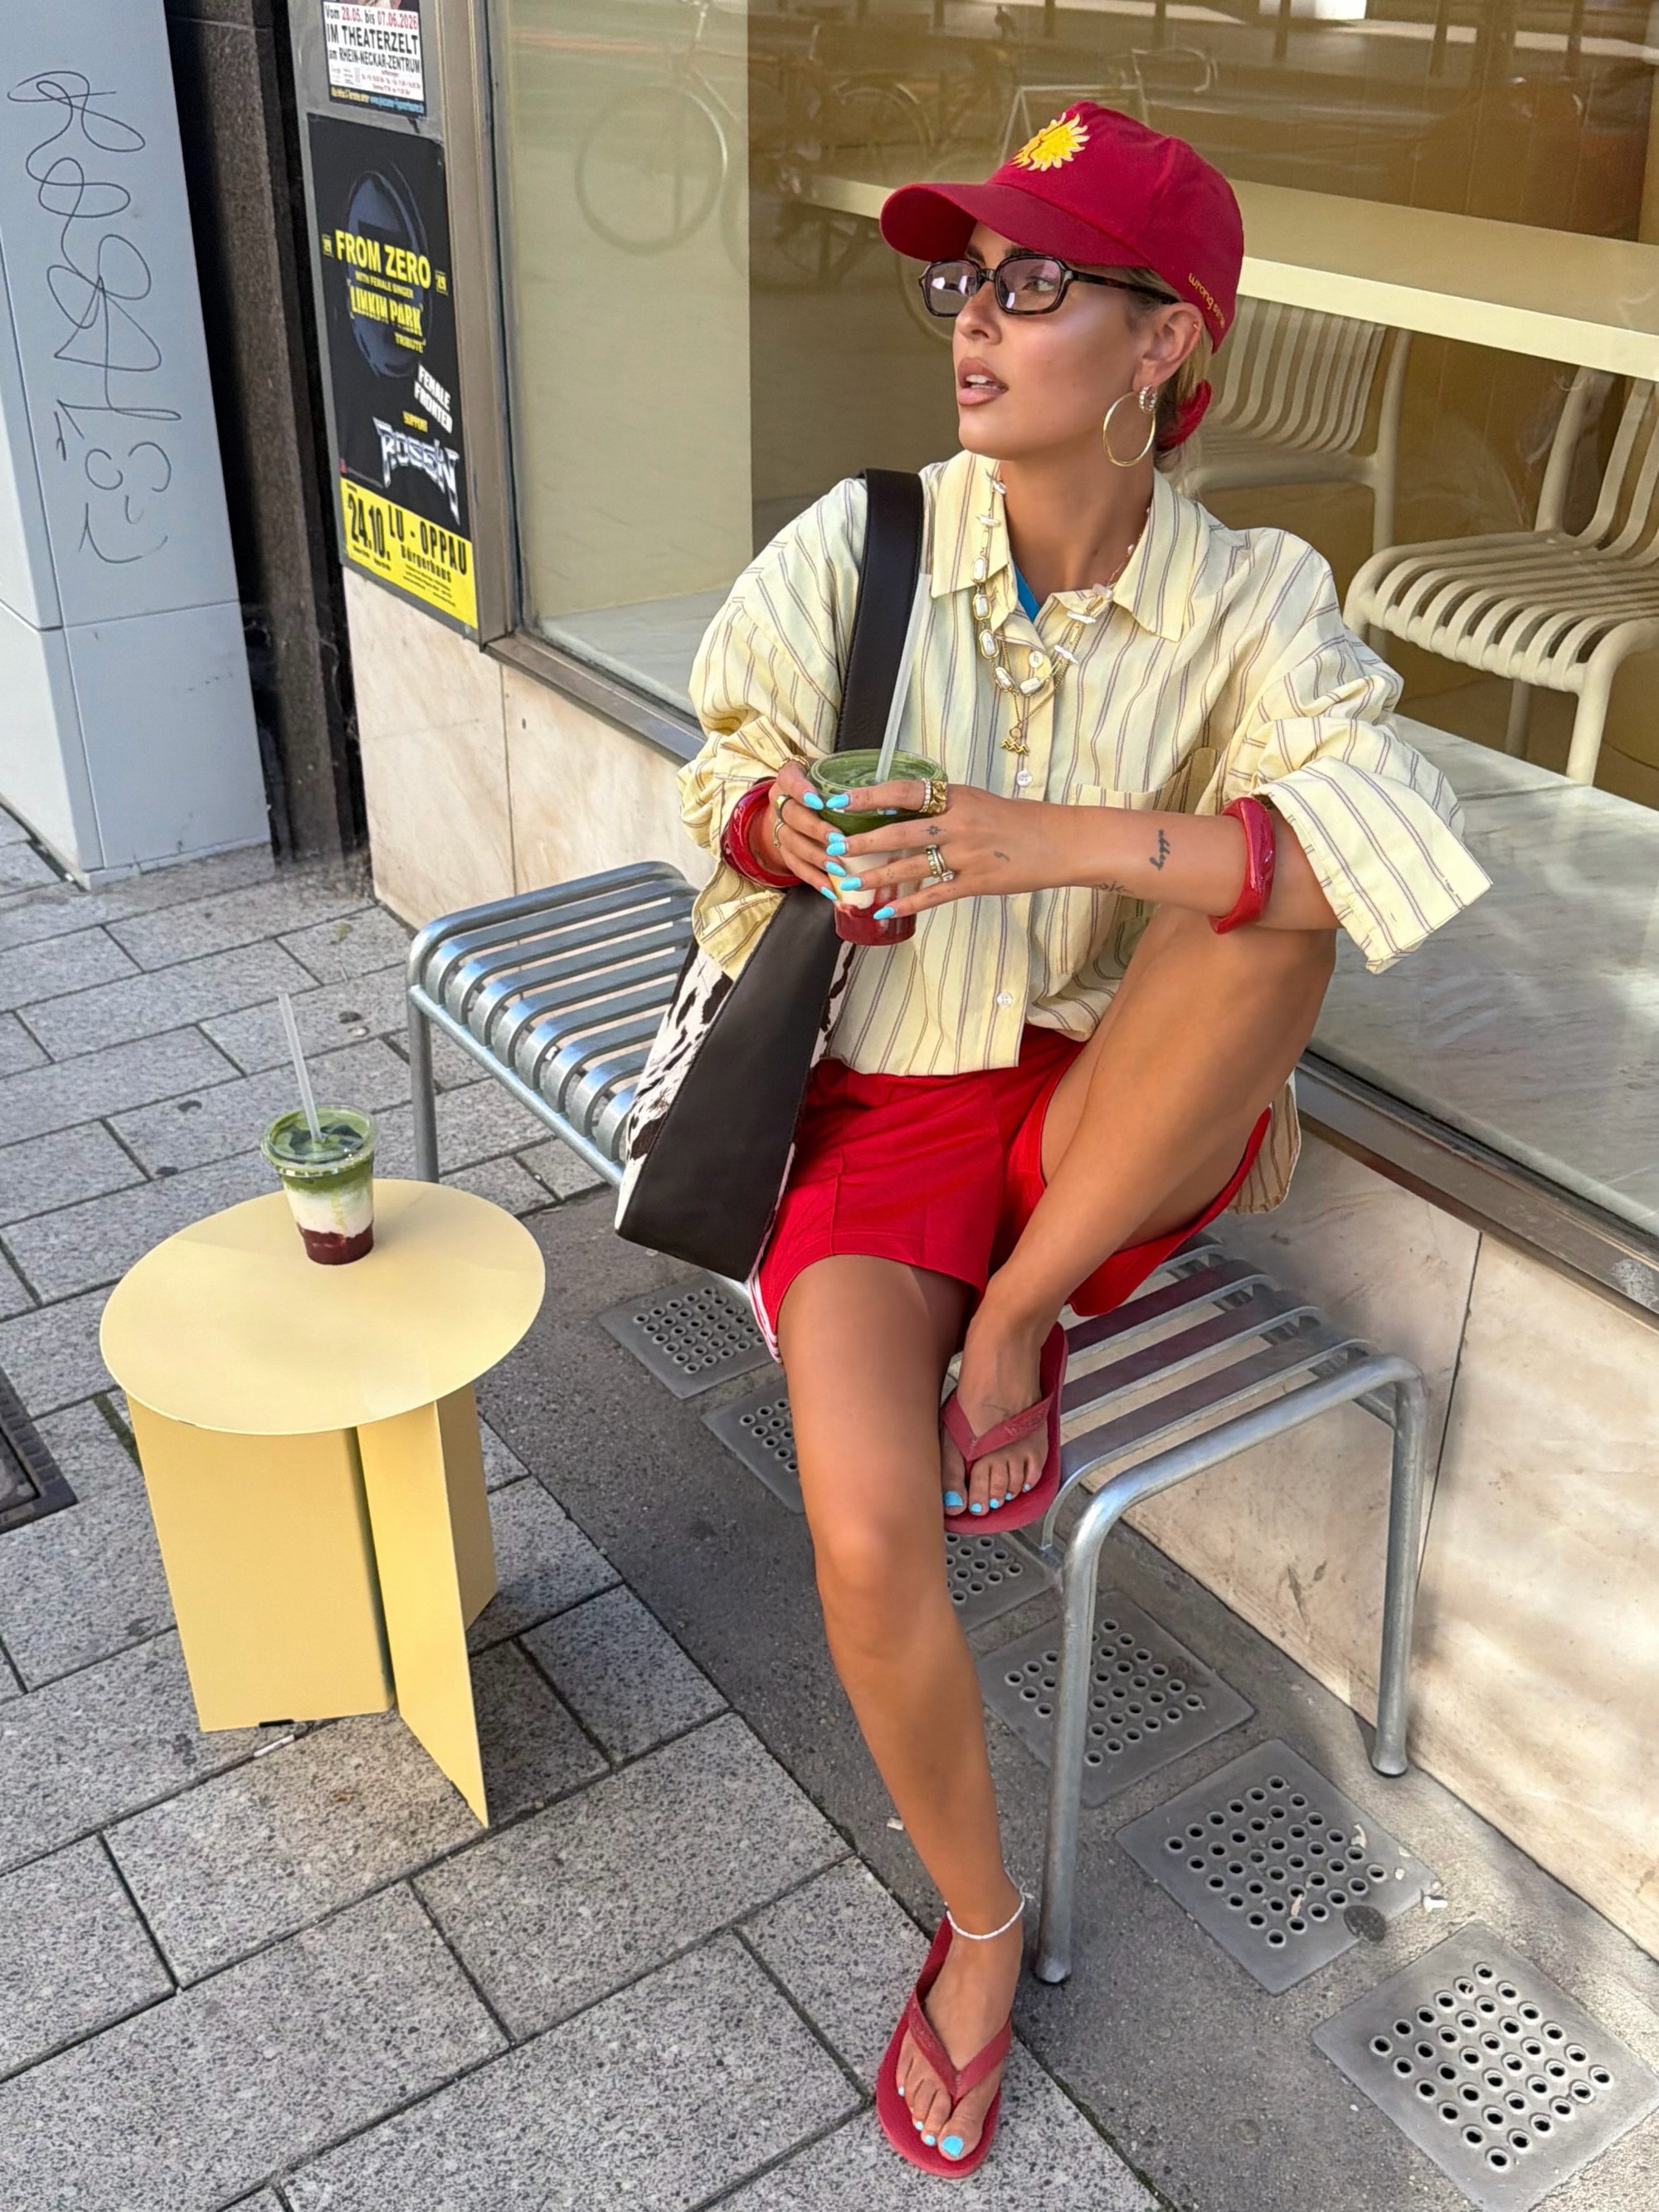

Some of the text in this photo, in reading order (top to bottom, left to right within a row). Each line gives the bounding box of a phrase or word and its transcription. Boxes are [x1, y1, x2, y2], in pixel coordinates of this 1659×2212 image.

[325, 5, 340, 19] Vom
[364, 8, 376, 25] bis
[326, 23, 418, 55] IM THEATERZELT
[338, 47, 421, 74] RHEIN-NECKAR-ZENTRUM
[335, 229, 382, 273] FROM
[384, 244, 431, 289] ZERO
[349, 285, 423, 337] LINKIN PARK
[1189, 273, 1214, 310] wrong
[418, 363, 451, 412] FEMALE
[348, 492, 392, 562] 24.10.
[387, 504, 405, 543] LU
[420, 520, 468, 576] OPPAU
